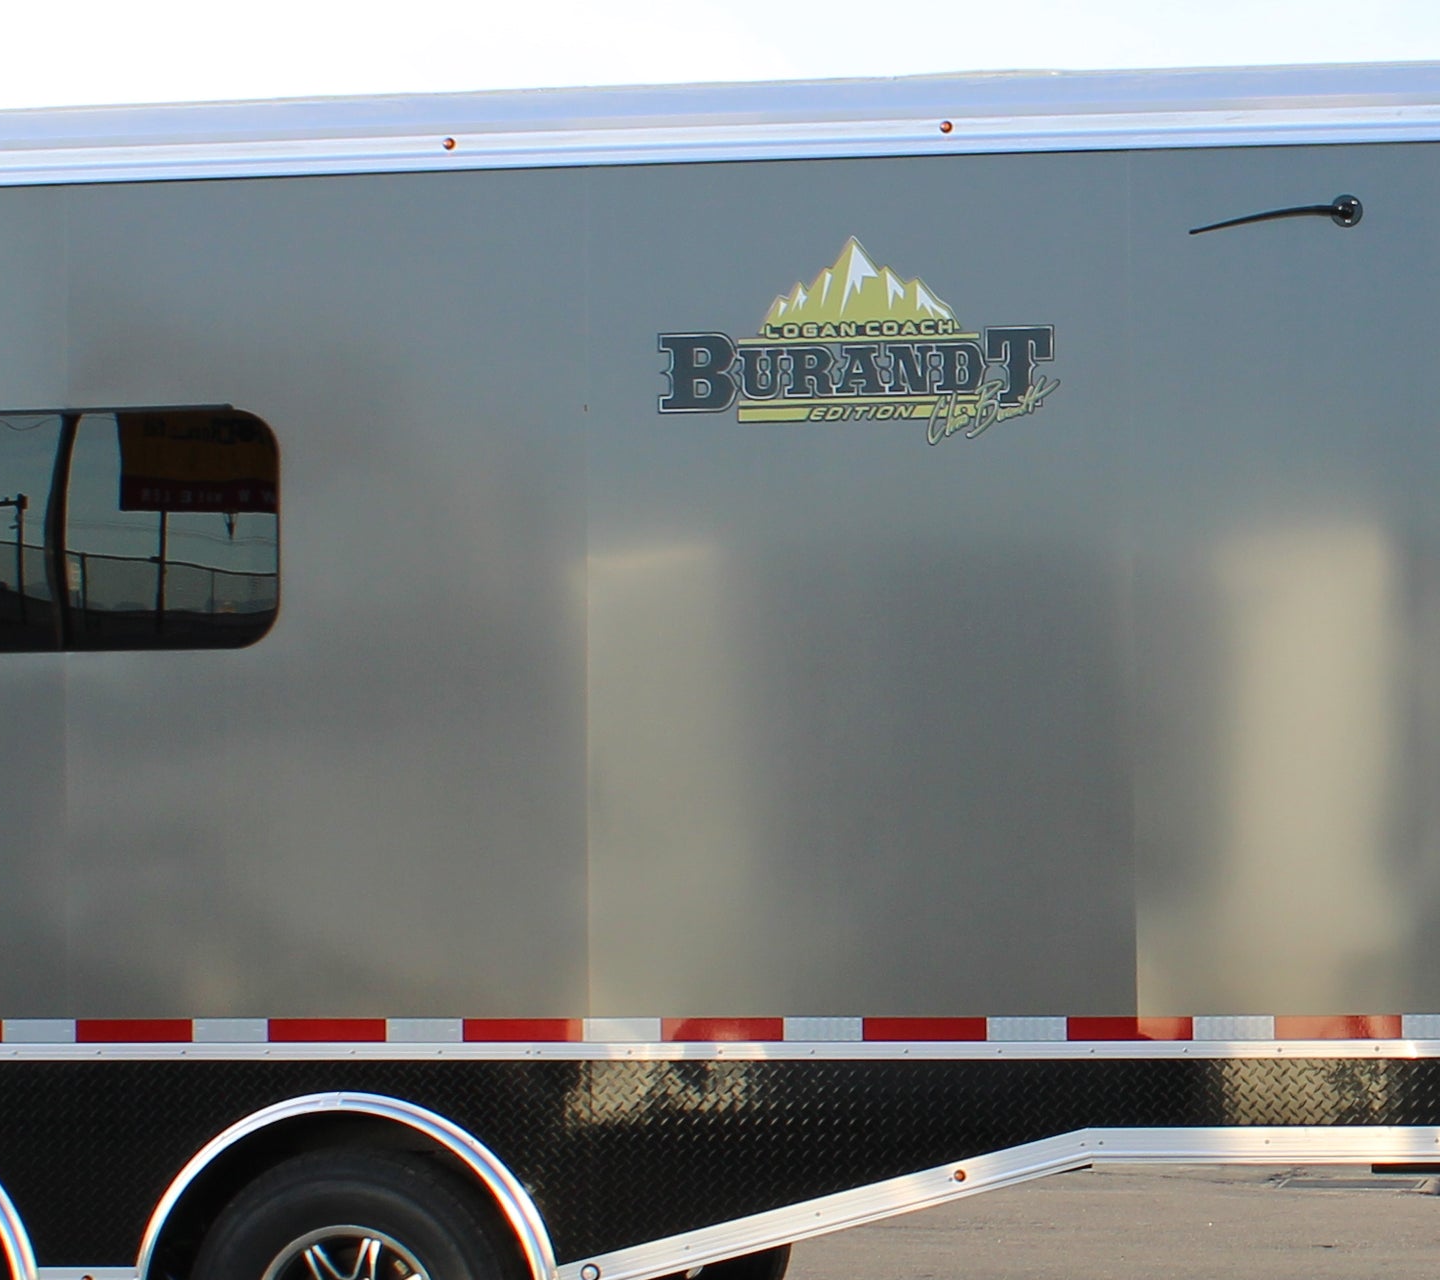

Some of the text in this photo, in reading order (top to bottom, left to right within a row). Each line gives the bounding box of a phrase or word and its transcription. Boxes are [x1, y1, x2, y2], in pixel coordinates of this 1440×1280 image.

[765, 319, 956, 340] LOGAN COACH
[657, 324, 1055, 415] BURANDT
[808, 404, 914, 423] EDITION
